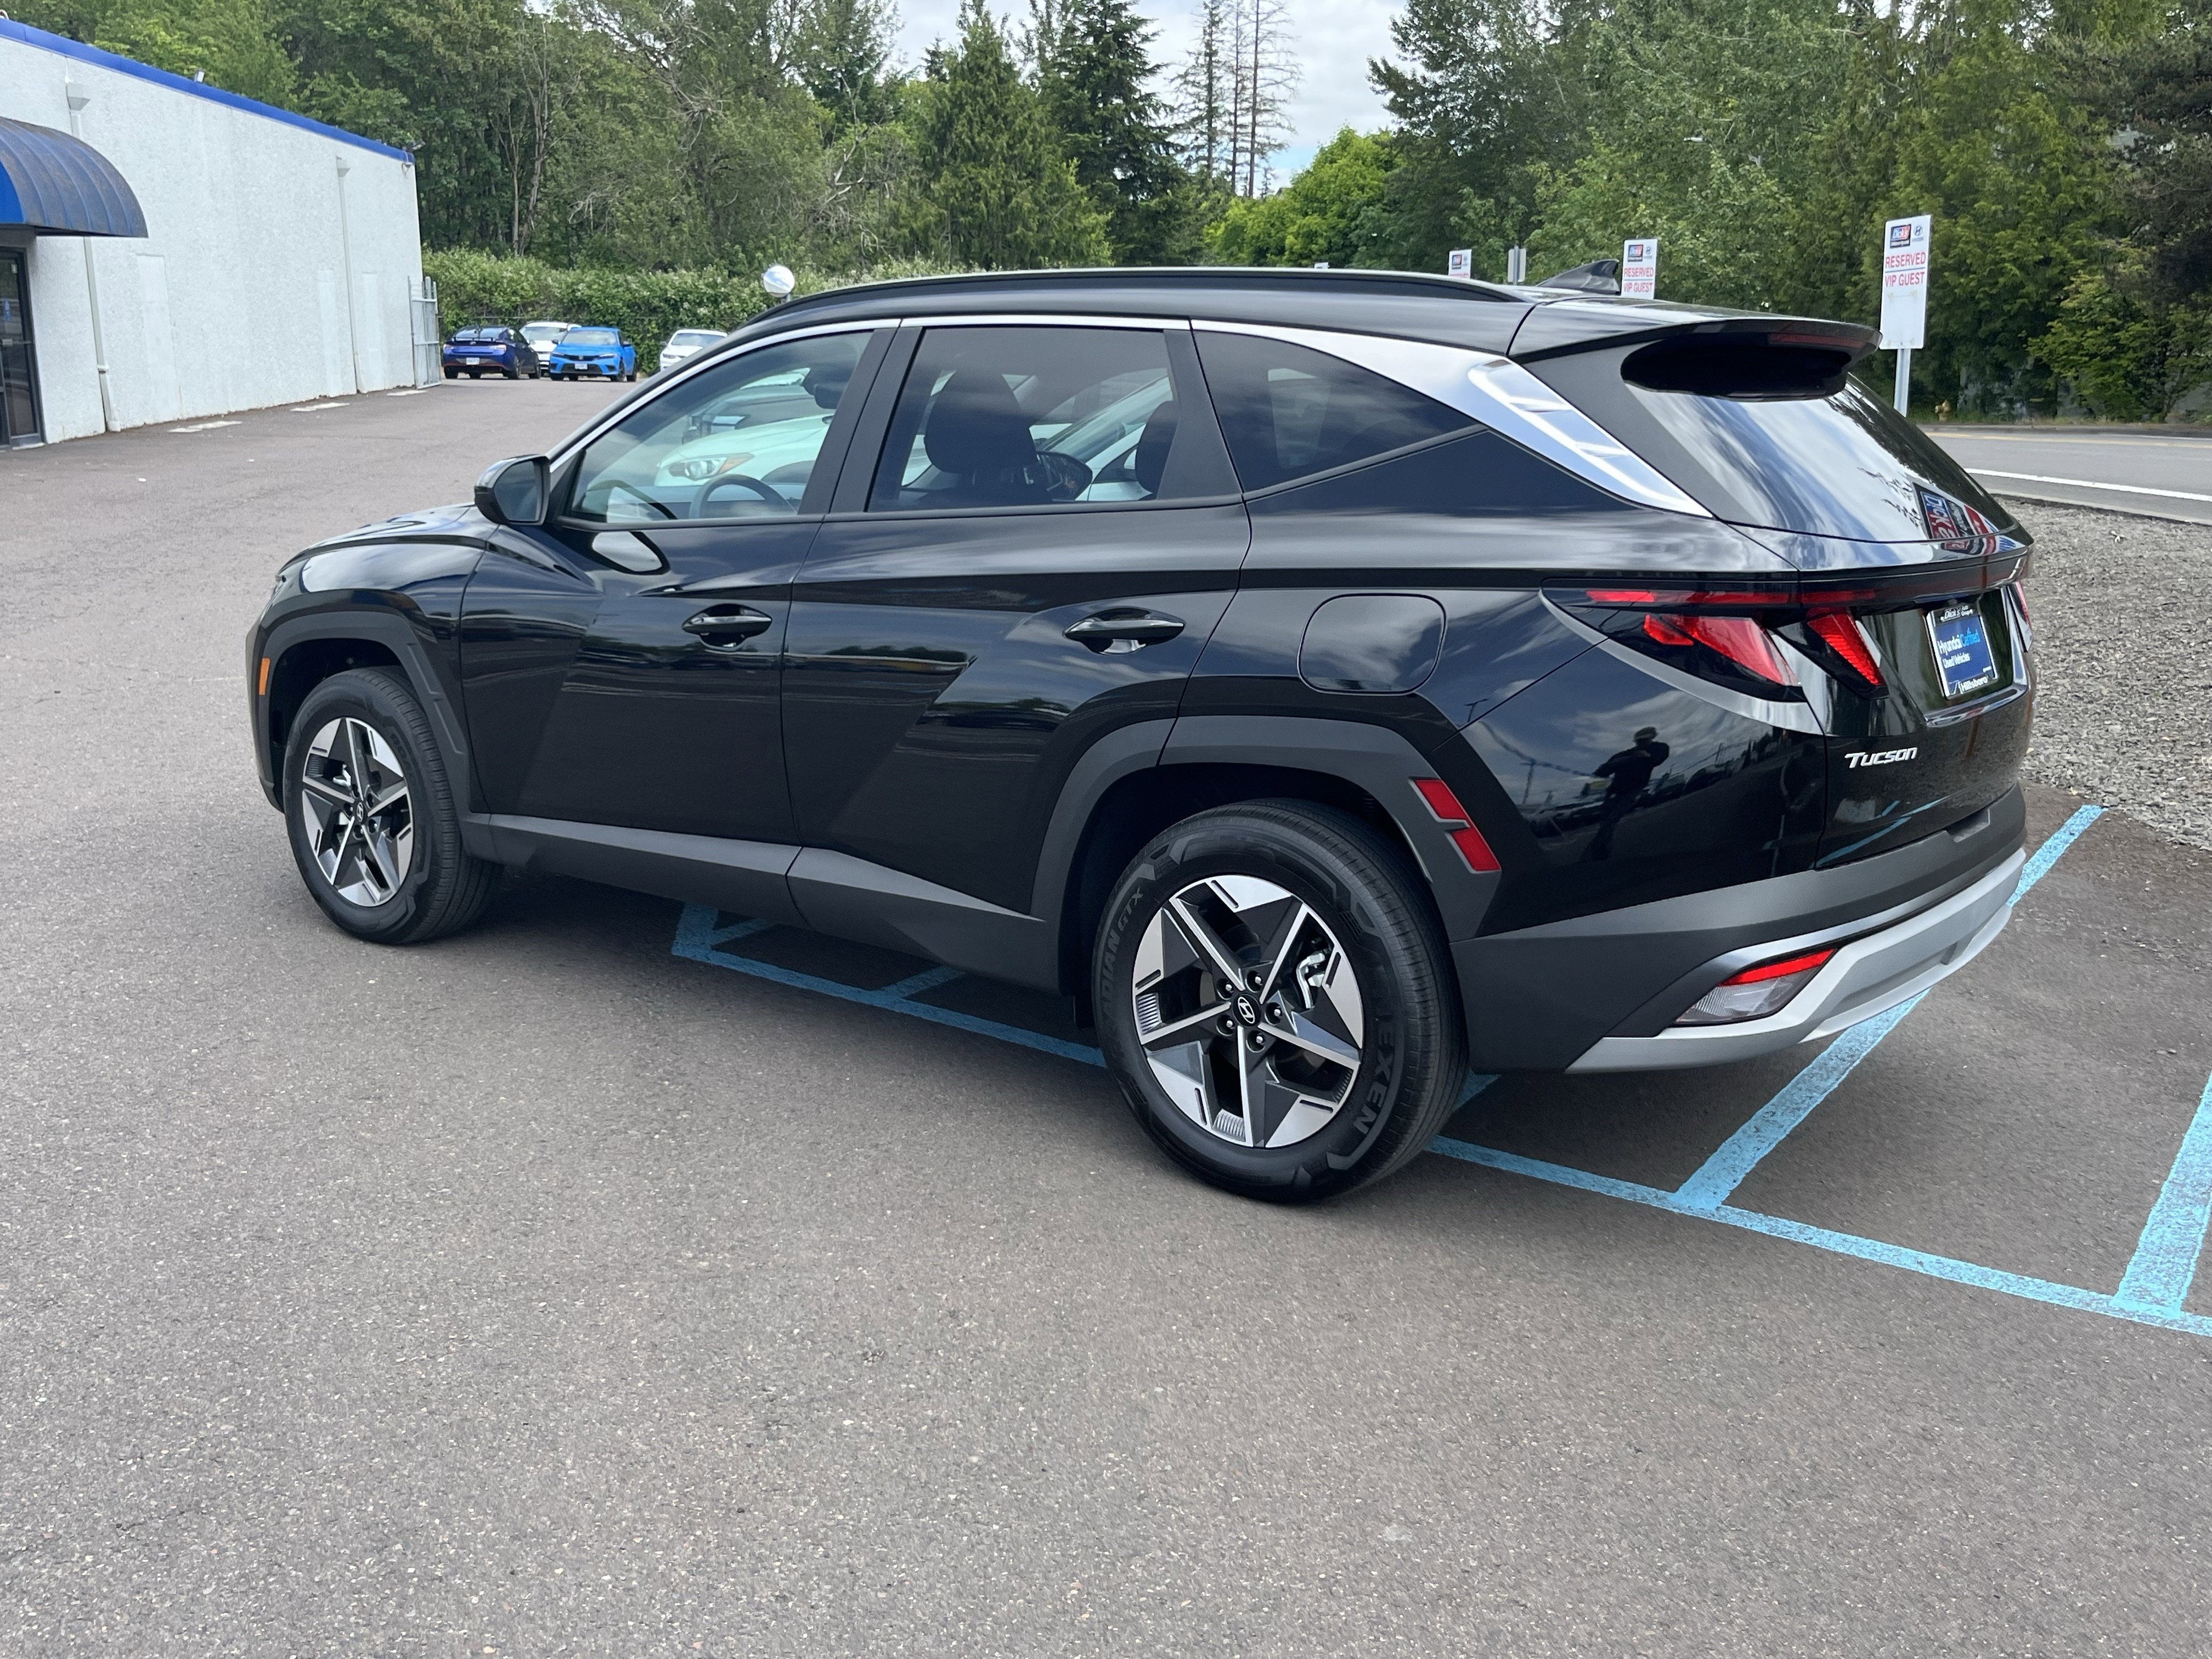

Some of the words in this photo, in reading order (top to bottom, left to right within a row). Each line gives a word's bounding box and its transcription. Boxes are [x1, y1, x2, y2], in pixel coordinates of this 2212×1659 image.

[1885, 252, 1926, 269] RESERVED
[1624, 267, 1654, 278] RESERVED
[1885, 275, 1897, 287] VIP
[1899, 272, 1925, 286] GUEST
[1624, 283, 1633, 293] VIP
[1634, 282, 1653, 293] GUEST
[1937, 634, 1962, 656] Hyundai
[1960, 676, 1988, 692] Hillsboro
[1844, 747, 1918, 769] Tucson
[1117, 887, 1144, 932] GTX
